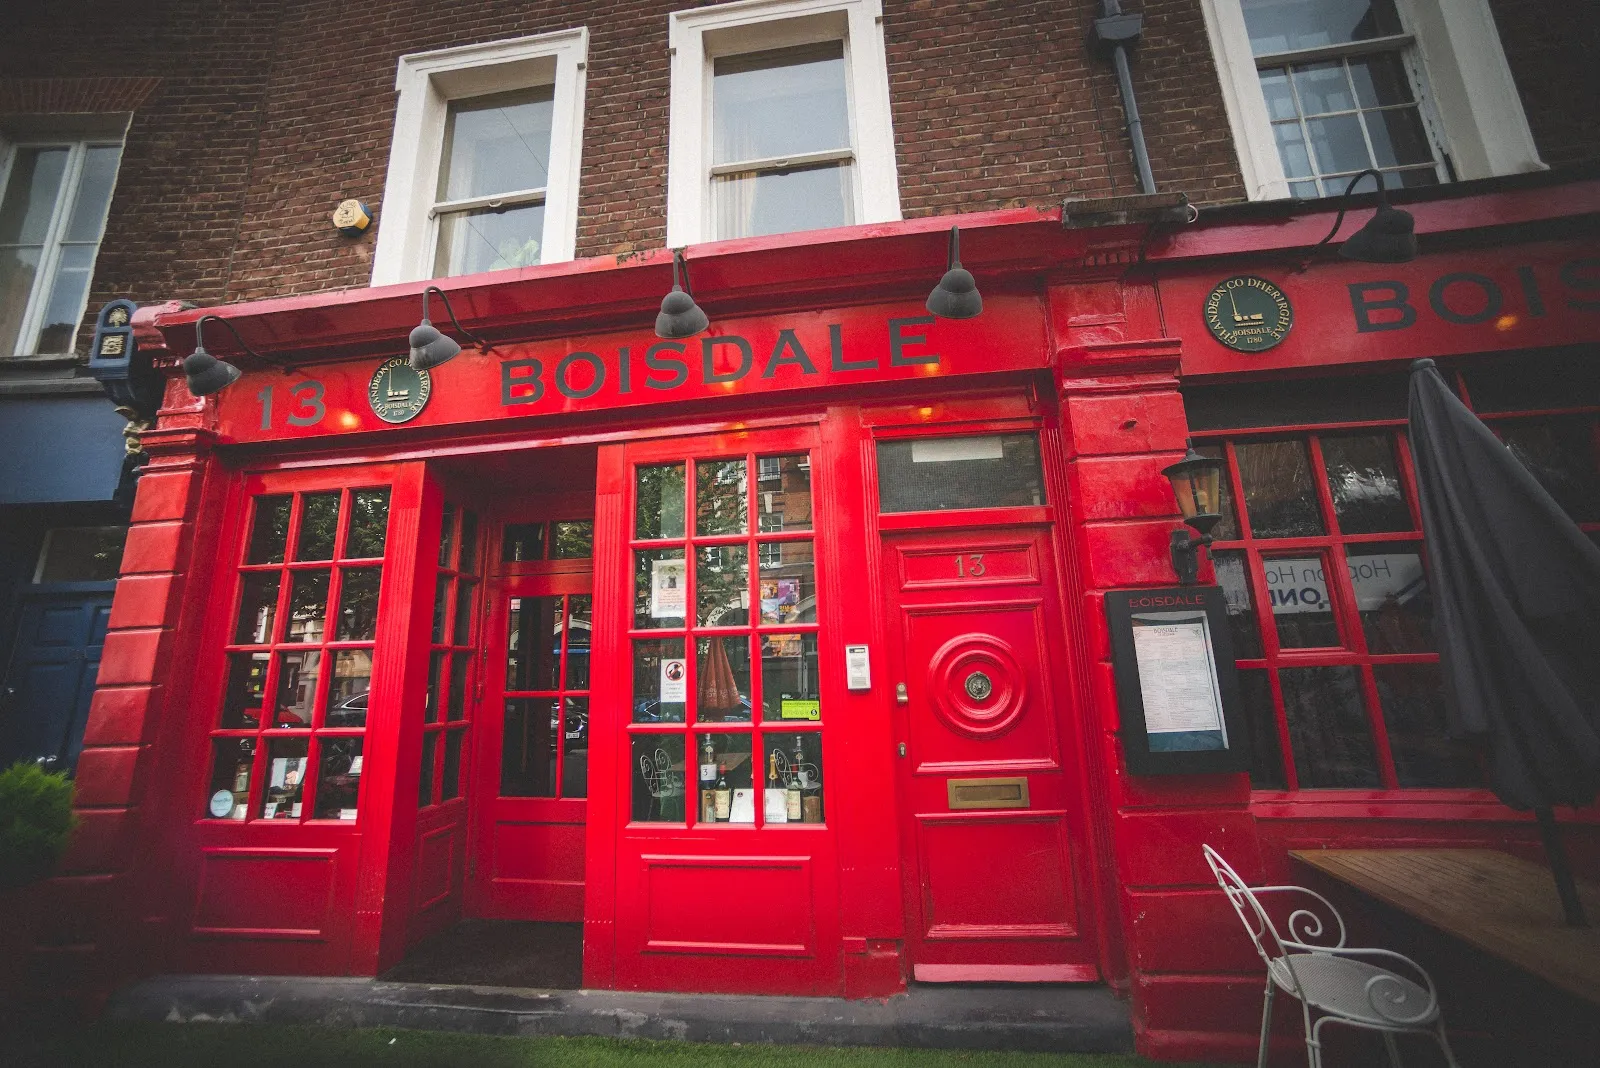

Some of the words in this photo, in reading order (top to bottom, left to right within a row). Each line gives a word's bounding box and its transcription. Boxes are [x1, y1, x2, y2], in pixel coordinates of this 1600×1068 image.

[1226, 278, 1244, 289] CO
[1232, 326, 1273, 337] BOISDALE
[1246, 336, 1263, 344] 1780
[389, 358, 402, 368] CO
[257, 379, 326, 431] 13
[501, 315, 941, 406] BOISDALE
[384, 401, 413, 410] BOISDALE
[954, 553, 986, 578] 13
[1128, 594, 1207, 608] BOISDALE
